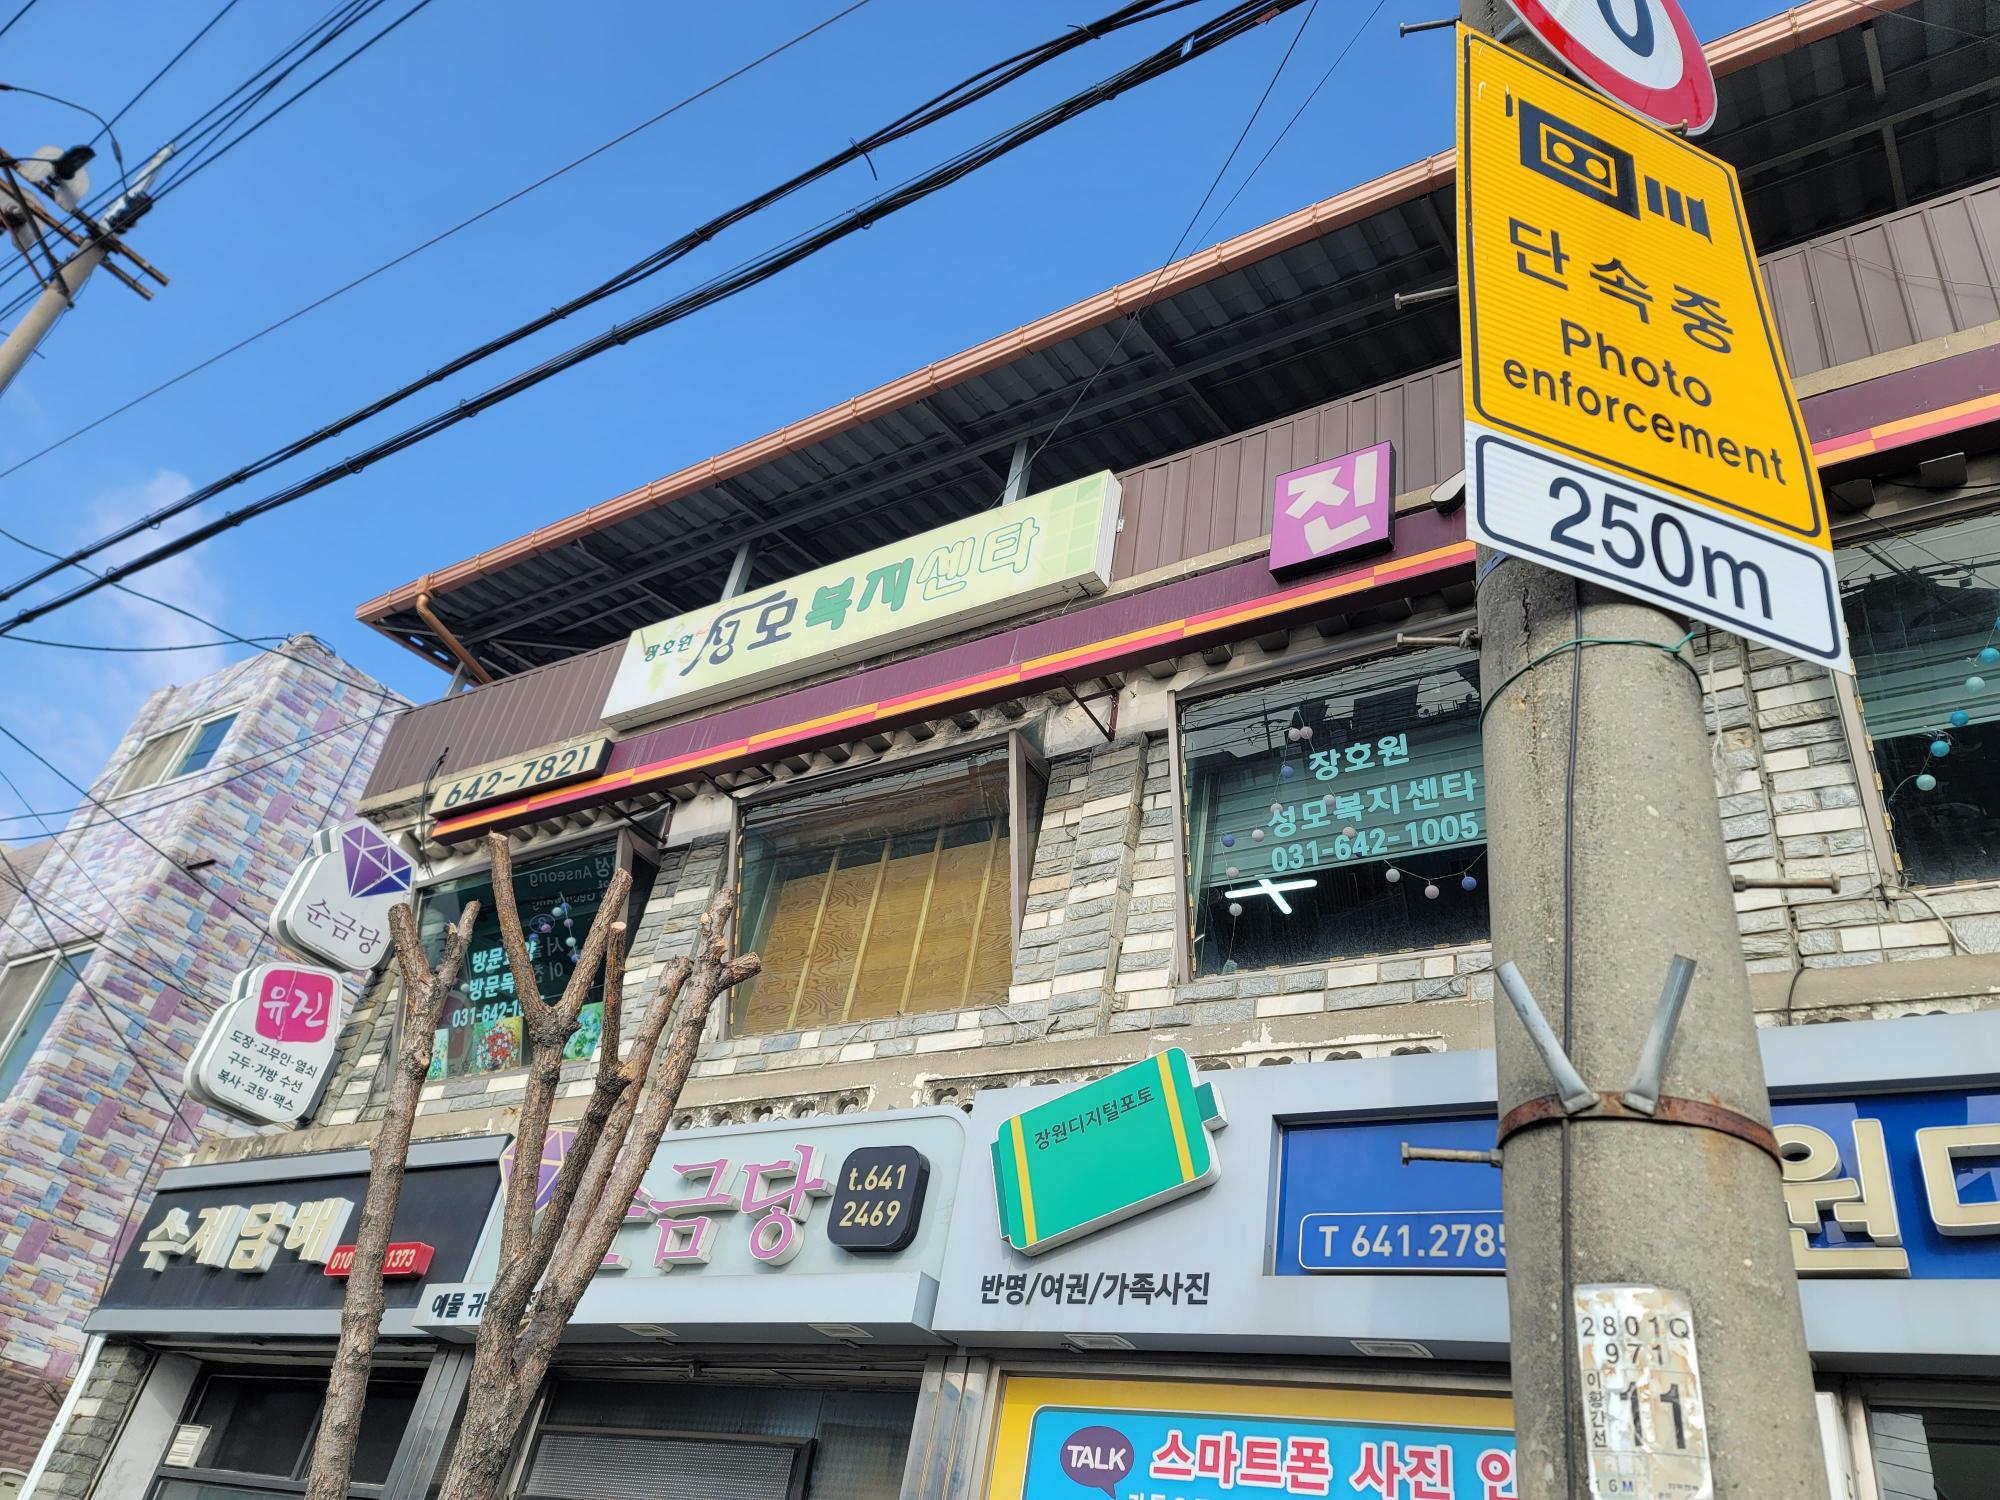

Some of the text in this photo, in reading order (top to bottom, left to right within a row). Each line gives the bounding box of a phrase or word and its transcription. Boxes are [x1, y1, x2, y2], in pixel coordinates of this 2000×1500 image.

[1508, 216, 1734, 355] 단속중
[1560, 317, 1712, 408] Photo
[1503, 359, 1786, 486] enforcement
[1284, 449, 1379, 556] 진
[1548, 476, 1774, 621] 250m
[443, 745, 591, 809] 642-7821
[1308, 732, 1410, 782] 장호원
[1271, 811, 1480, 873] 031-642-1005
[306, 899, 381, 955] 순금당
[263, 986, 325, 1028] 유진
[279, 1075, 303, 1094] 수선
[1034, 1086, 1156, 1152] 장원디지털포토
[601, 1143, 835, 1273] 금당
[848, 1164, 907, 1192] t.641
[139, 1198, 350, 1273] 수제담배
[839, 1200, 901, 1228] 2469
[1318, 1225, 1340, 1257] T
[432, 1292, 465, 1319] 예물
[1605, 1343, 1664, 1365] 971
[1619, 1382, 1686, 1449] 11
[1067, 1445, 1127, 1471] TALK
[1150, 1431, 1334, 1495] 스마트폰
[1350, 1441, 1455, 1500] 사진
